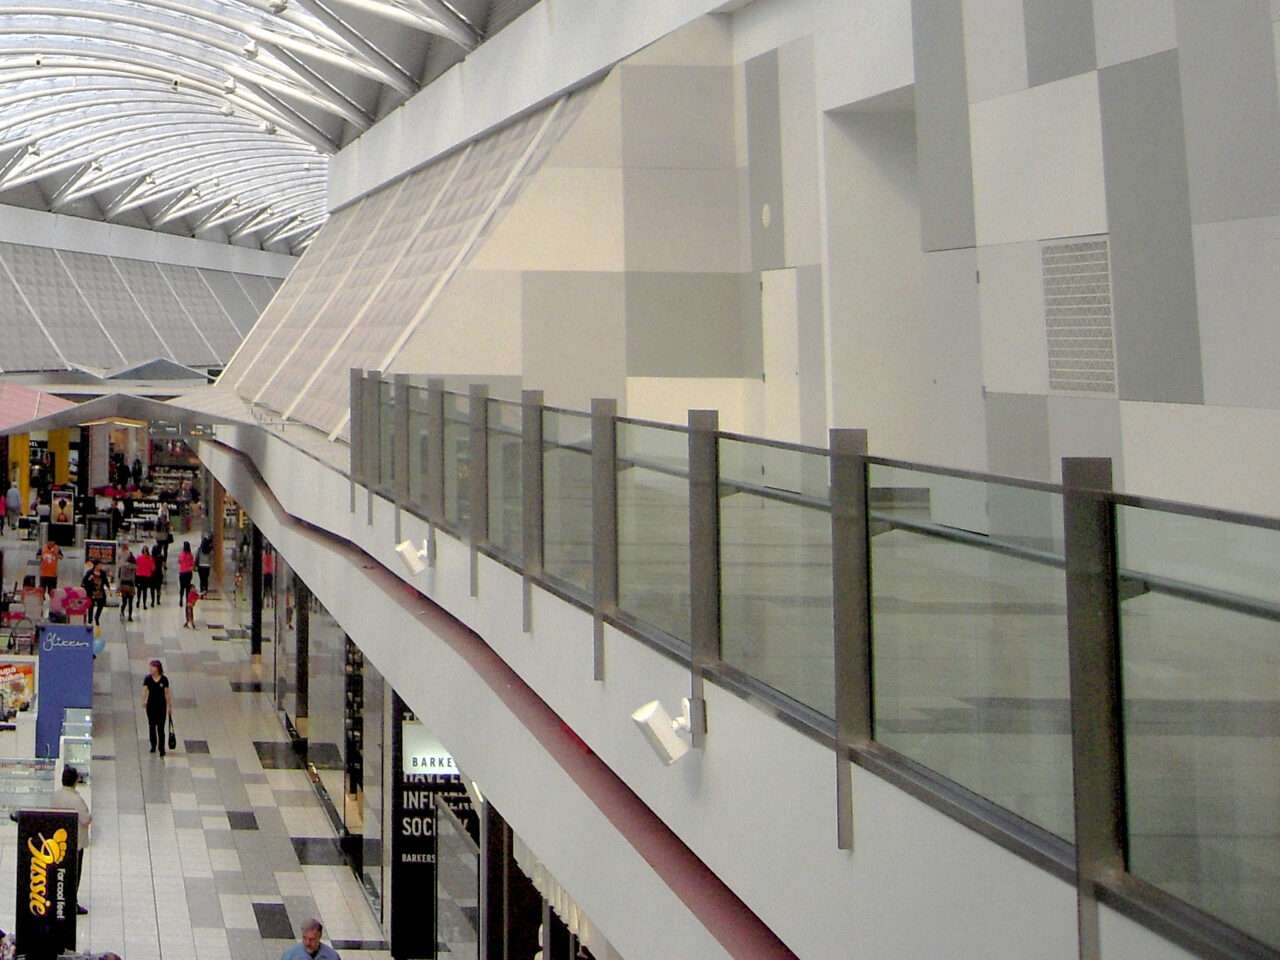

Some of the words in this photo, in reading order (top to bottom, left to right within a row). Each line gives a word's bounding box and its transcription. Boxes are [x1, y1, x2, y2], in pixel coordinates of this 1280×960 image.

[412, 757, 455, 768] BARKE
[402, 854, 436, 863] BARKERS
[27, 832, 57, 916] Aussie
